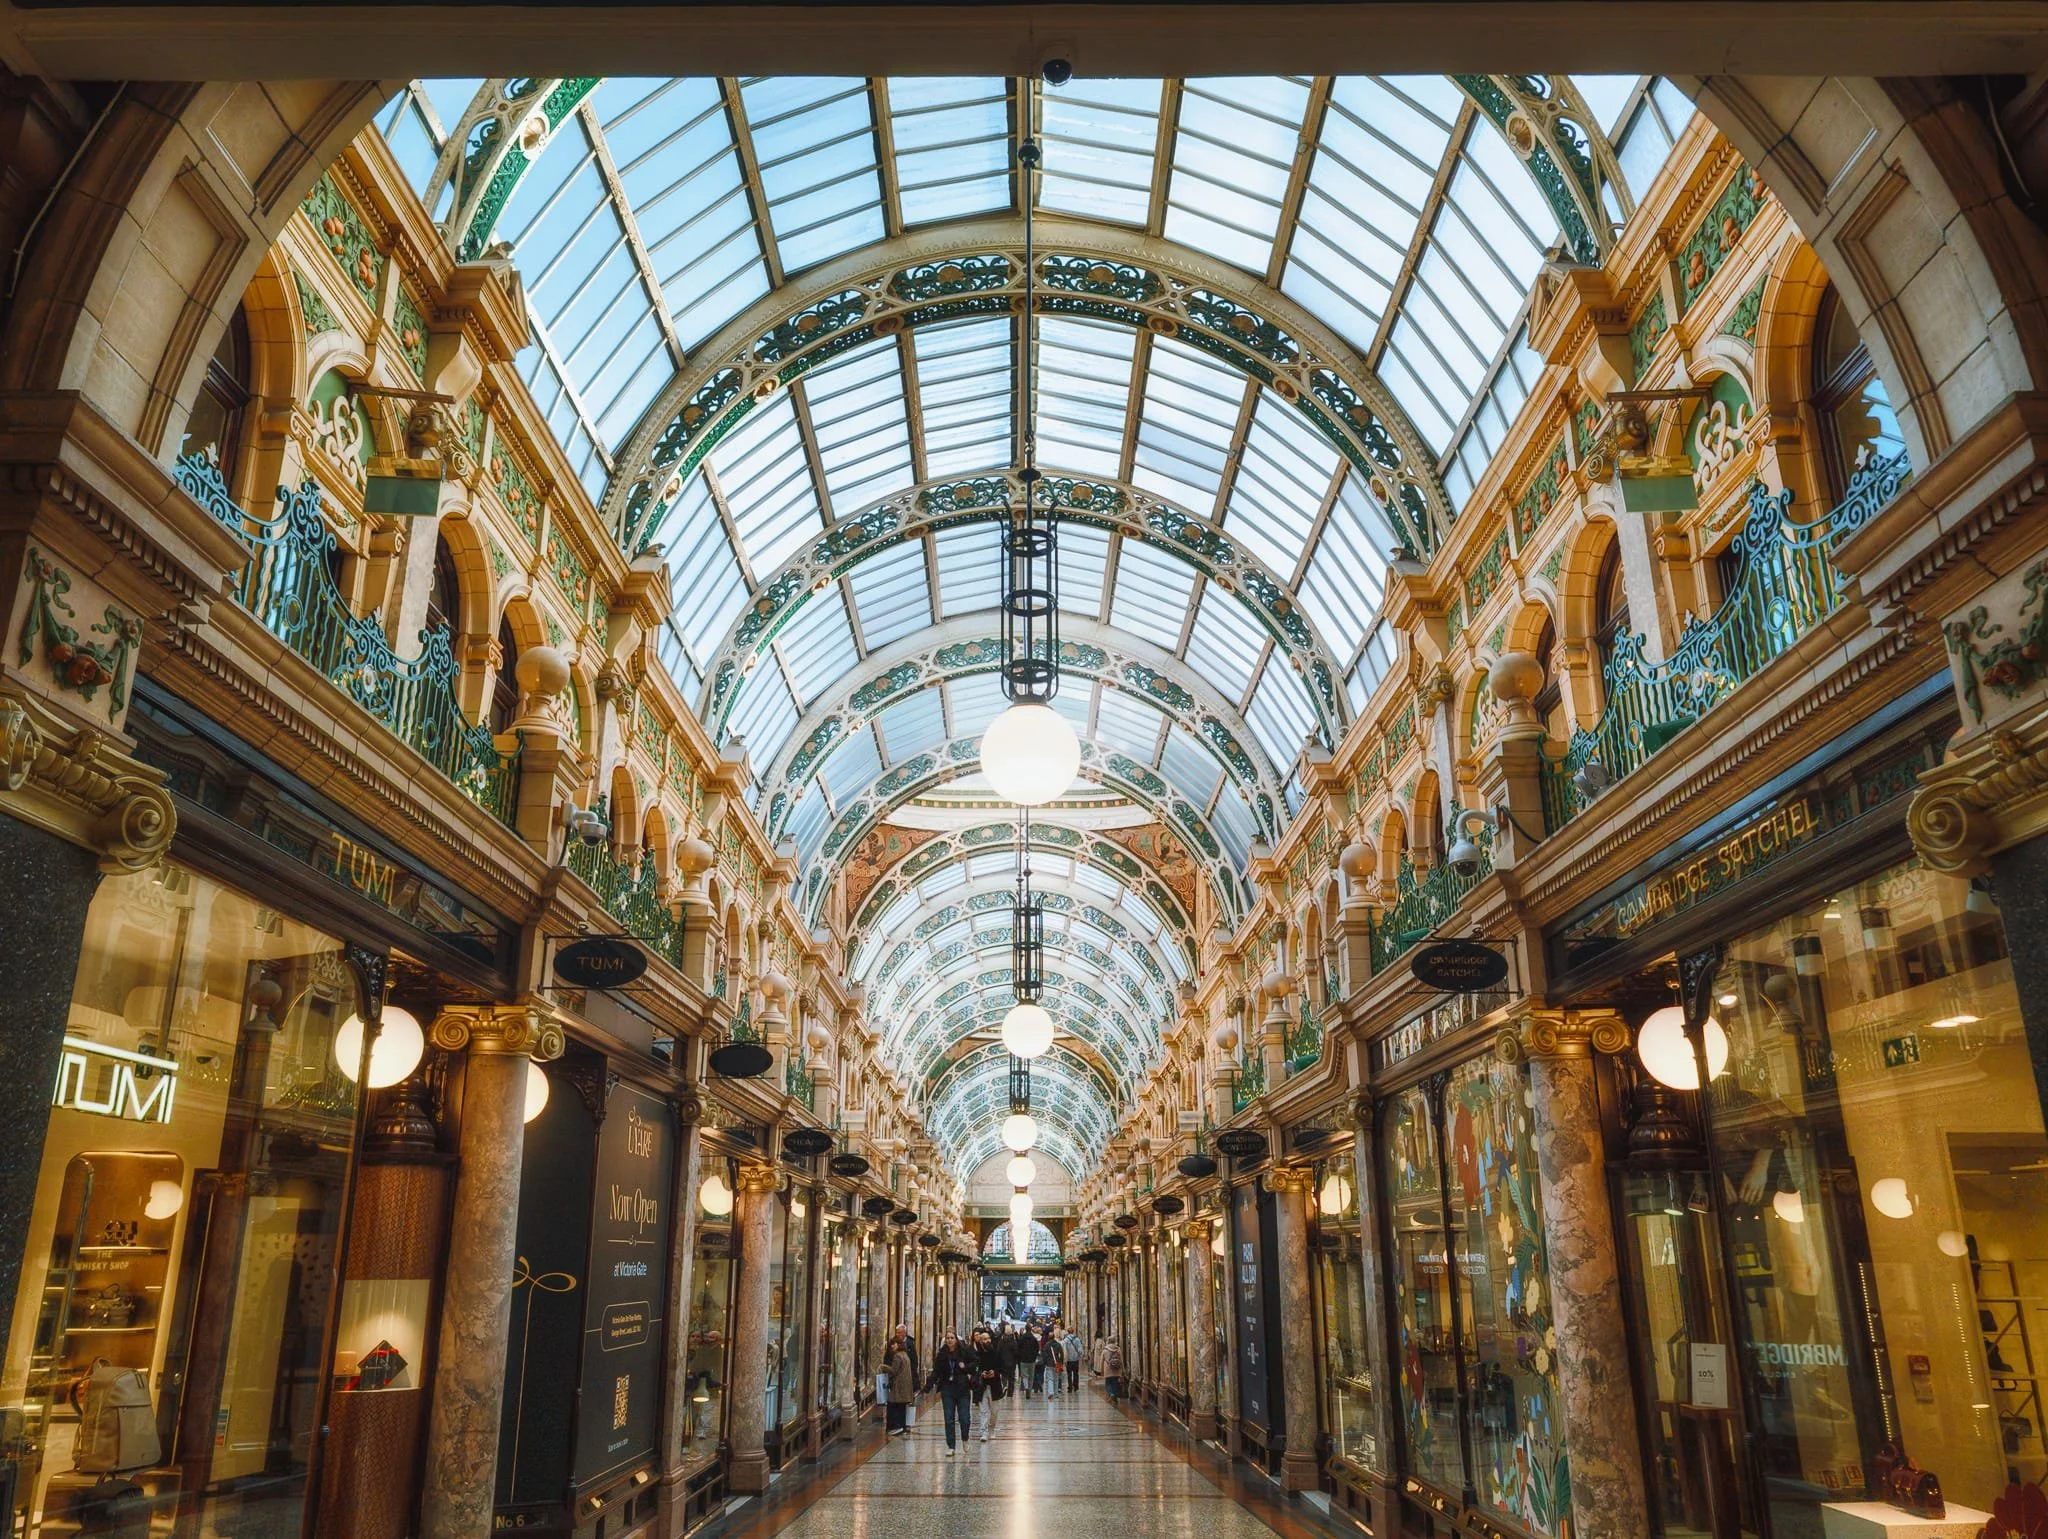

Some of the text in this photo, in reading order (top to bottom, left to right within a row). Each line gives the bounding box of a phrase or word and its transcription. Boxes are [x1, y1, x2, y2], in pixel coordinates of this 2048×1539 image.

[331, 831, 396, 909] TUMI
[1616, 797, 1819, 933] CAMBRIDGE SATCHEL
[575, 956, 625, 970] TUMI
[609, 1183, 658, 1234] Now Open
[97, 1250, 113, 1259] THE
[75, 1261, 129, 1271] WHISKY SHOP
[637, 1260, 648, 1276] Gate
[496, 1514, 525, 1529] No 6
